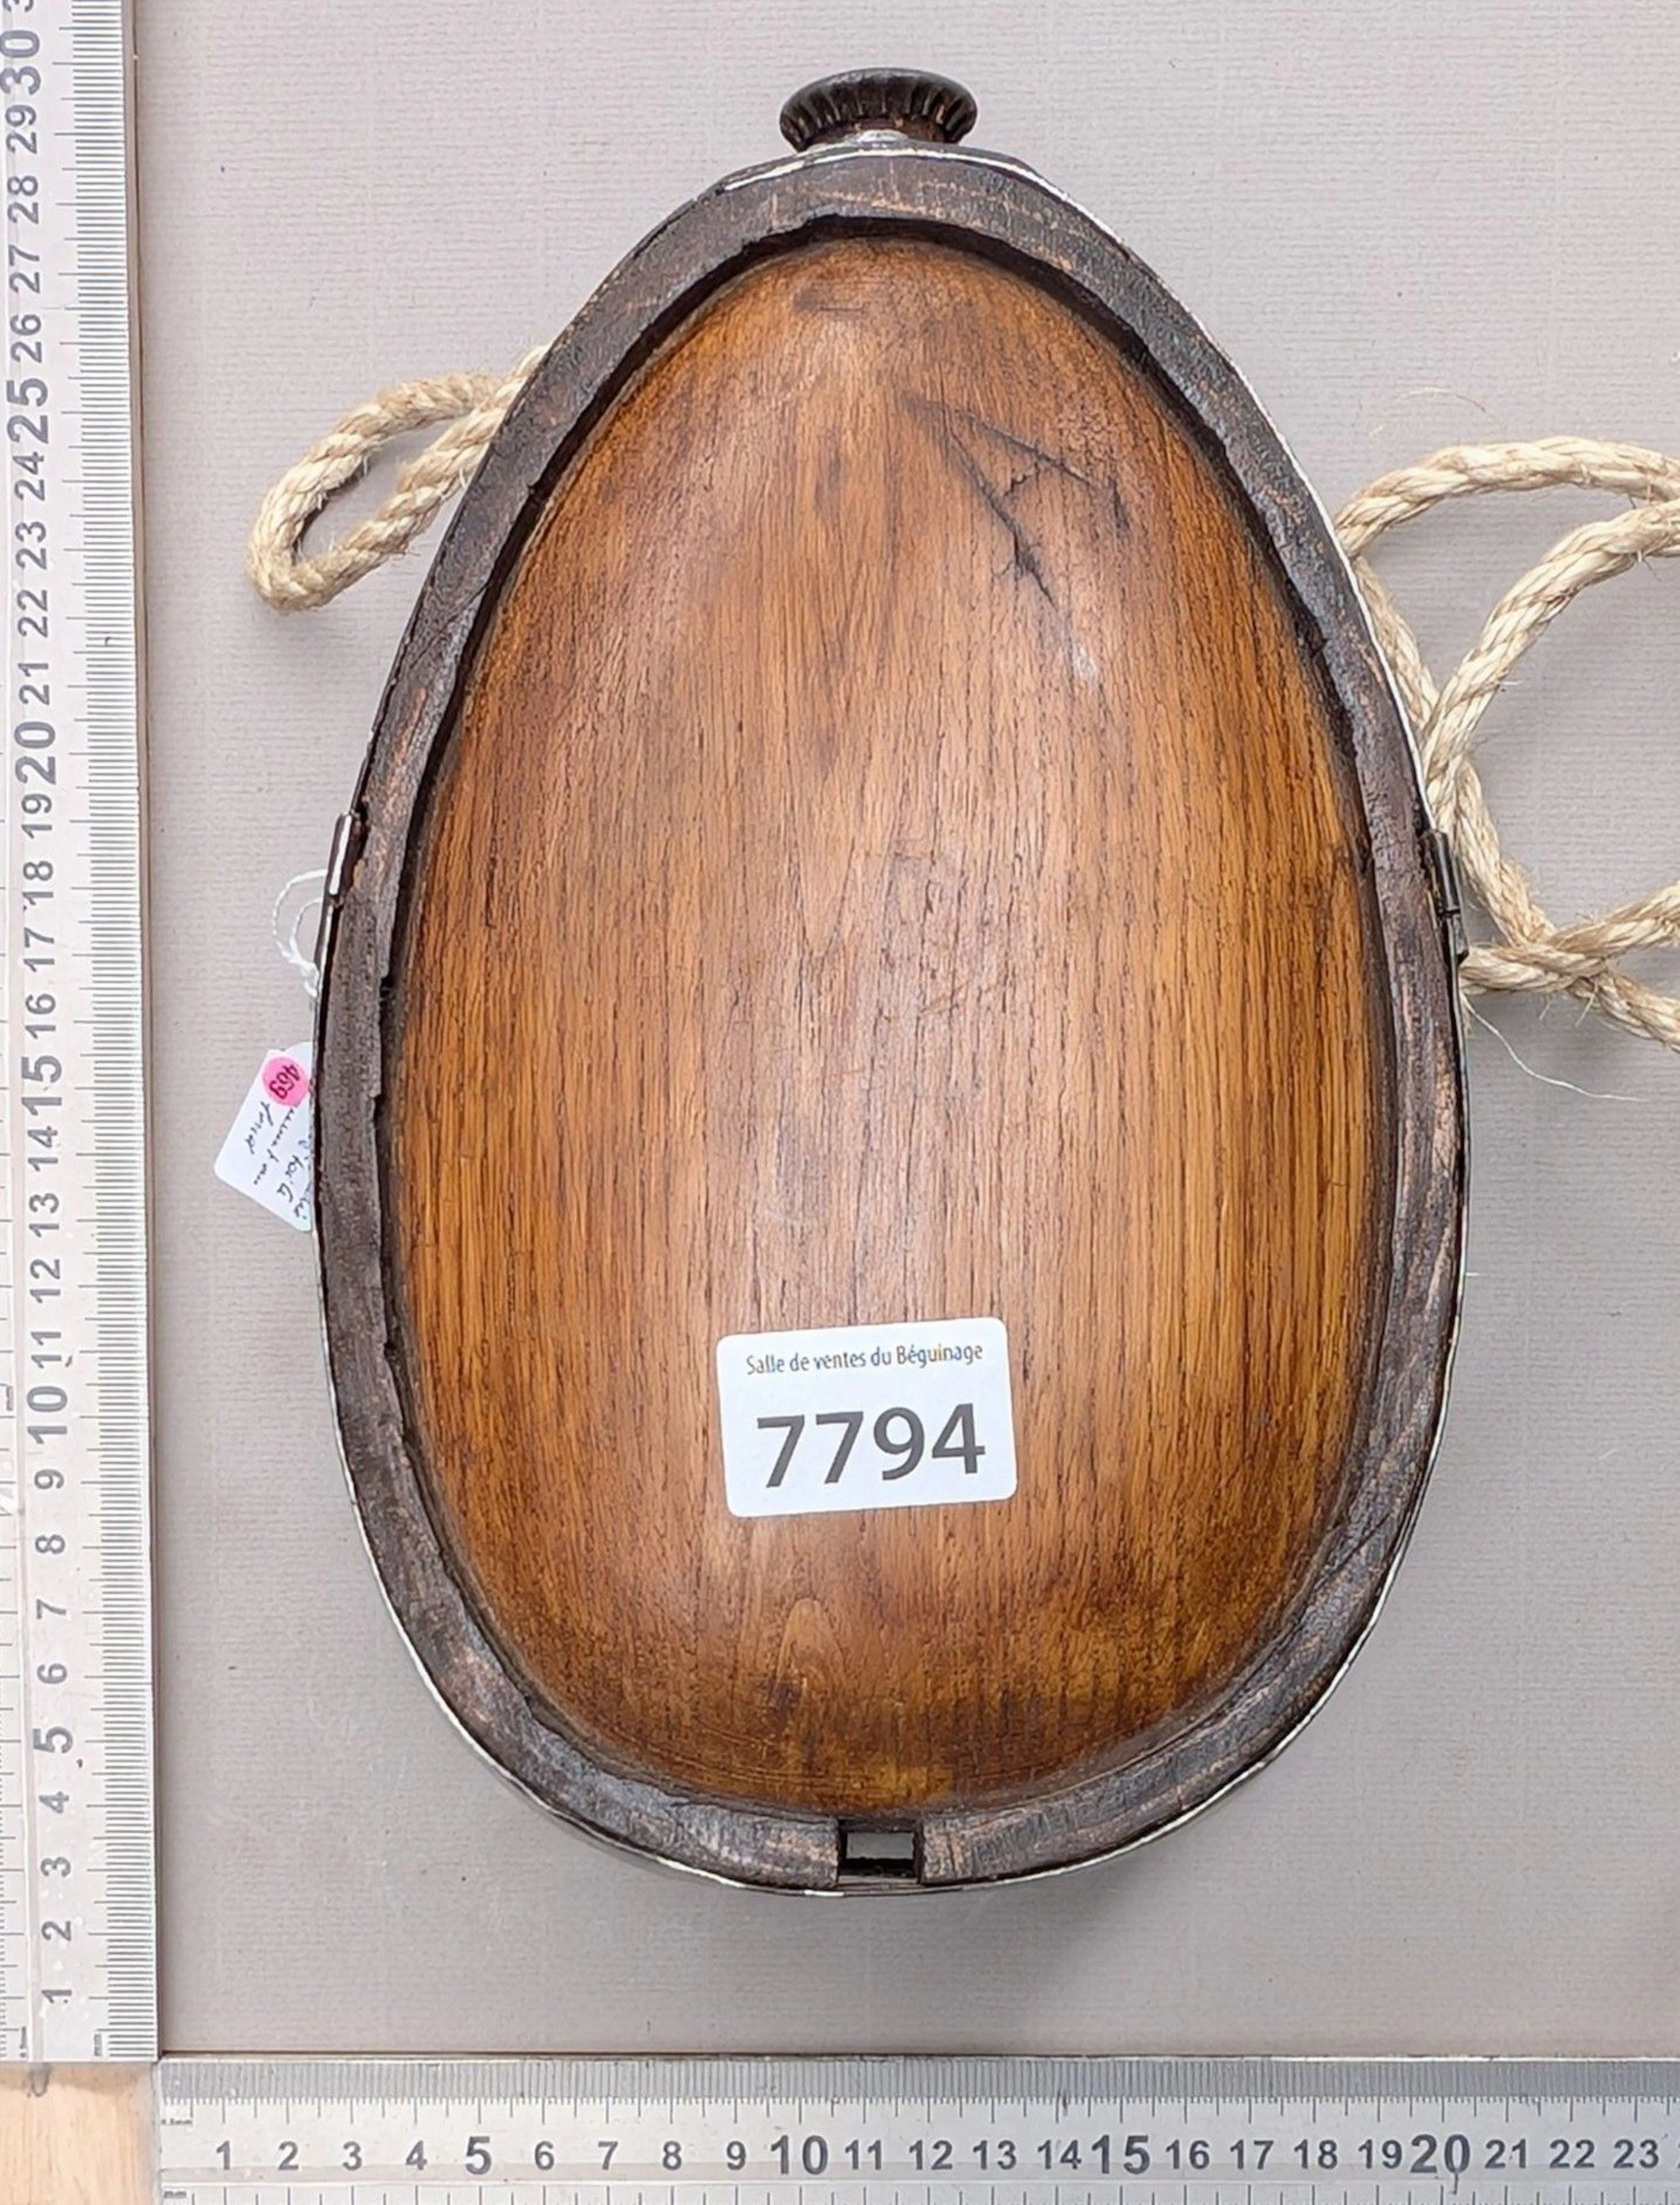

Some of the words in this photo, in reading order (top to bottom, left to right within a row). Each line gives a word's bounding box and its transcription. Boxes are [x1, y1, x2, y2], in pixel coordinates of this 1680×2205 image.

[0, 30, 41, 95] 30
[5, 105, 37, 154] 29
[7, 175, 39, 224] 28
[8, 244, 40, 294] 27
[9, 314, 42, 364] 26
[6, 378, 49, 445] 25
[12, 451, 45, 501] 24
[14, 521, 47, 571] 23
[16, 589, 48, 638] 22
[17, 663, 50, 706] 21
[13, 721, 56, 785] 20
[21, 793, 52, 839] 19
[22, 860, 54, 906] 18
[23, 927, 55, 973] 17
[24, 993, 56, 1040] 16
[21, 1055, 62, 1116] 15
[269, 1063, 301, 1100] 469
[27, 1125, 59, 1172] 14
[28, 1193, 60, 1238] 13
[29, 1259, 61, 1304] 12
[31, 1331, 62, 1369] 11
[746, 1354, 785, 1375] Salle
[789, 1352, 810, 1372] de
[813, 1352, 866, 1370] ventes
[870, 1346, 892, 1367] du
[896, 1343, 983, 1369] Béguinage
[26, 1386, 68, 1444] 10
[757, 1402, 986, 1489] 7794
[34, 1469, 64, 1490] 9
[35, 1534, 66, 1555] 8
[36, 1599, 66, 1620] 7
[37, 1663, 67, 1684] 6
[32, 1727, 73, 1753] 5
[38, 1791, 69, 1814] 4
[40, 1857, 71, 1877] 3
[41, 1921, 72, 1942] 2
[41, 1989, 72, 2004] 1
[216, 2140, 231, 2170] 1
[277, 2141, 299, 2171] 2
[341, 2141, 362, 2172] 3
[405, 2140, 427, 2171] 4
[465, 2136, 492, 2176] 5
[534, 2141, 554, 2171] 6
[598, 2141, 619, 2171] 7
[662, 2141, 682, 2171] 8
[726, 2141, 746, 2171] 9
[770, 2135, 828, 2176] 10
[845, 2139, 882, 2171] 11
[909, 2139, 953, 2171] 12
[973, 2140, 1017, 2170] 13
[1037, 2139, 1082, 2170] 14
[1092, 2135, 1150, 2175] 15
[1166, 2139, 1209, 2170] 16
[1230, 2139, 1274, 2171] 17
[1294, 2139, 1337, 2170] 18
[1358, 2139, 1402, 2170] 19
[1410, 2134, 1470, 2173] 20
[1484, 2138, 1526, 2170] 21
[1548, 2139, 1595, 2170] 22
[1613, 2139, 1659, 2169] 23
